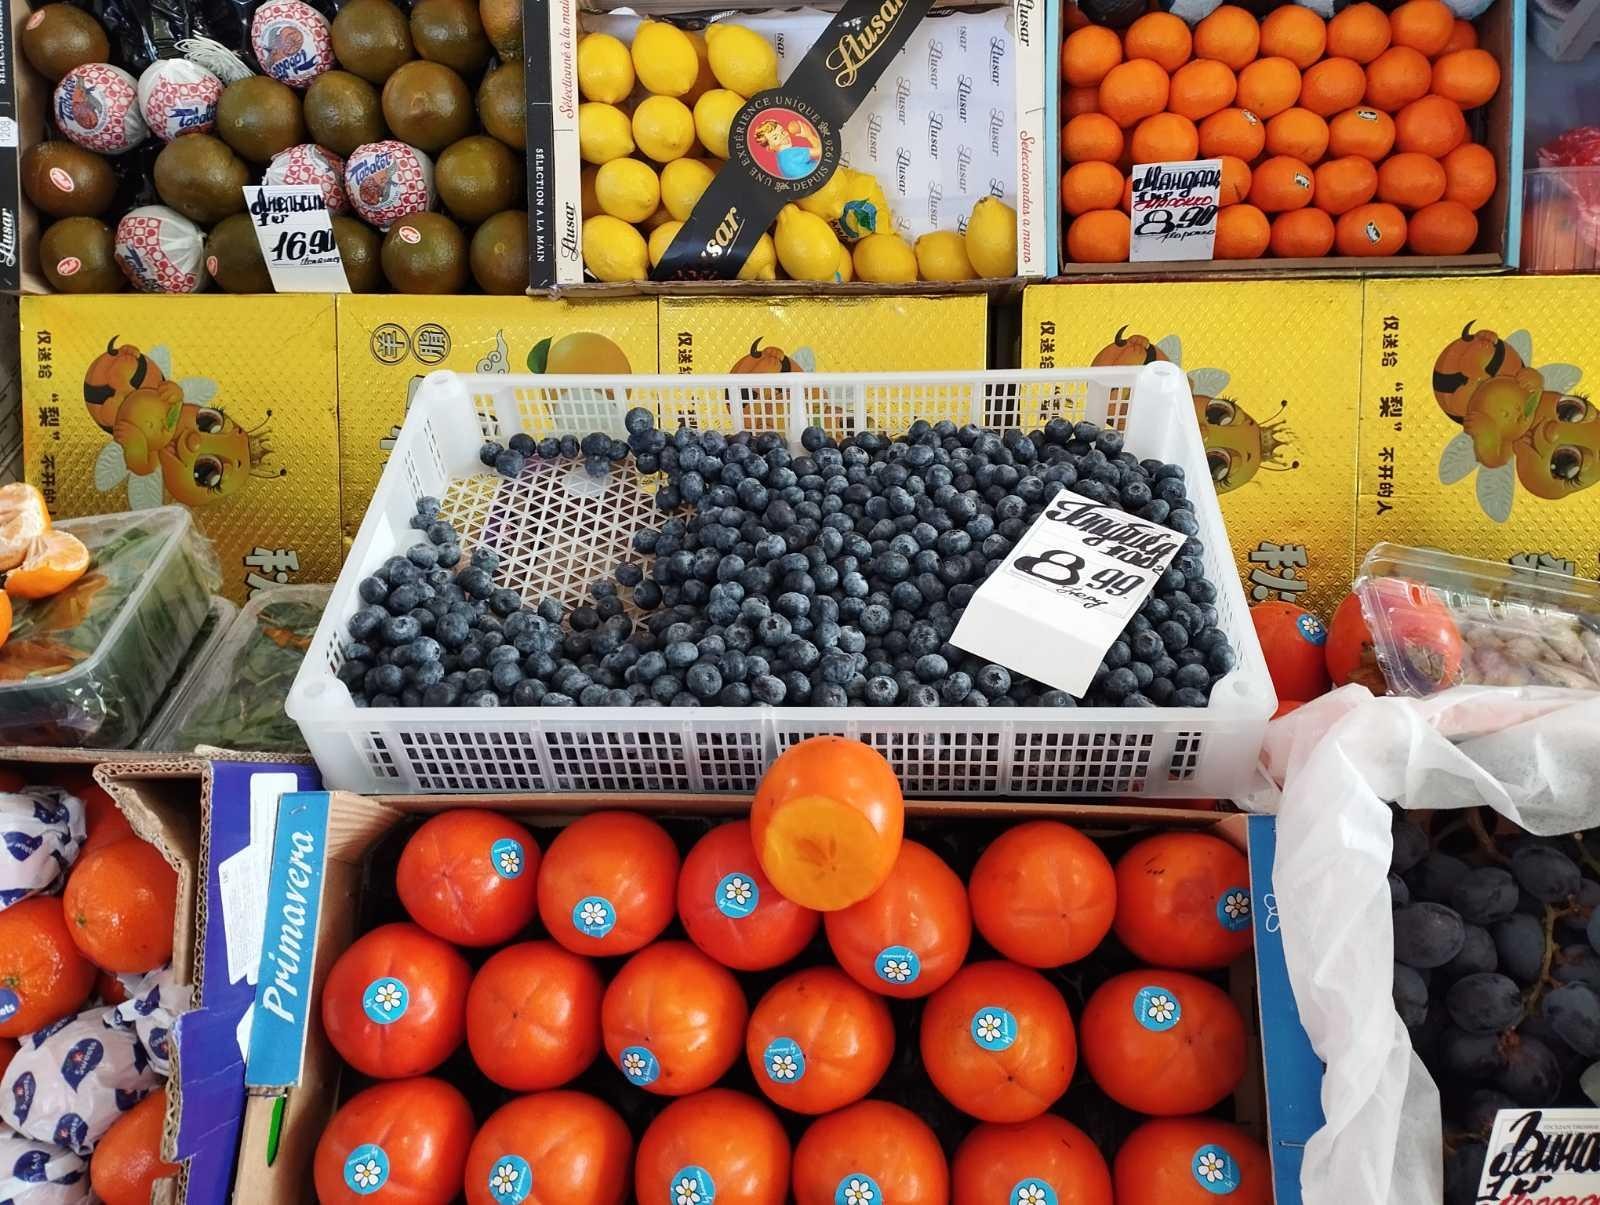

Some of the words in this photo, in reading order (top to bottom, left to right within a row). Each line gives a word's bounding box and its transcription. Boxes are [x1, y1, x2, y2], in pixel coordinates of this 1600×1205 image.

[562, 0, 570, 25] mai
[928, 38, 943, 90] Llusar
[990, 36, 1005, 87] Llusar
[896, 76, 911, 126] Llusar
[957, 74, 972, 124] Llusar
[734, 97, 771, 167] EXPÉRIENCE
[775, 95, 820, 122] UNIQUE
[928, 110, 943, 160] Llusar
[989, 107, 1004, 158] Llusar
[536, 148, 544, 206] SÉLECTION
[793, 166, 829, 191] DEPUIS
[896, 146, 911, 196] Llusar
[957, 143, 972, 194] Llusar
[537, 219, 544, 232] LA
[561, 201, 578, 261] Llusar
[37, 330, 52, 378] 仅送给
[1382, 316, 1399, 367] 仅送给
[1376, 446, 1394, 515] 不开的人
[262, 829, 316, 1025] Primavera
